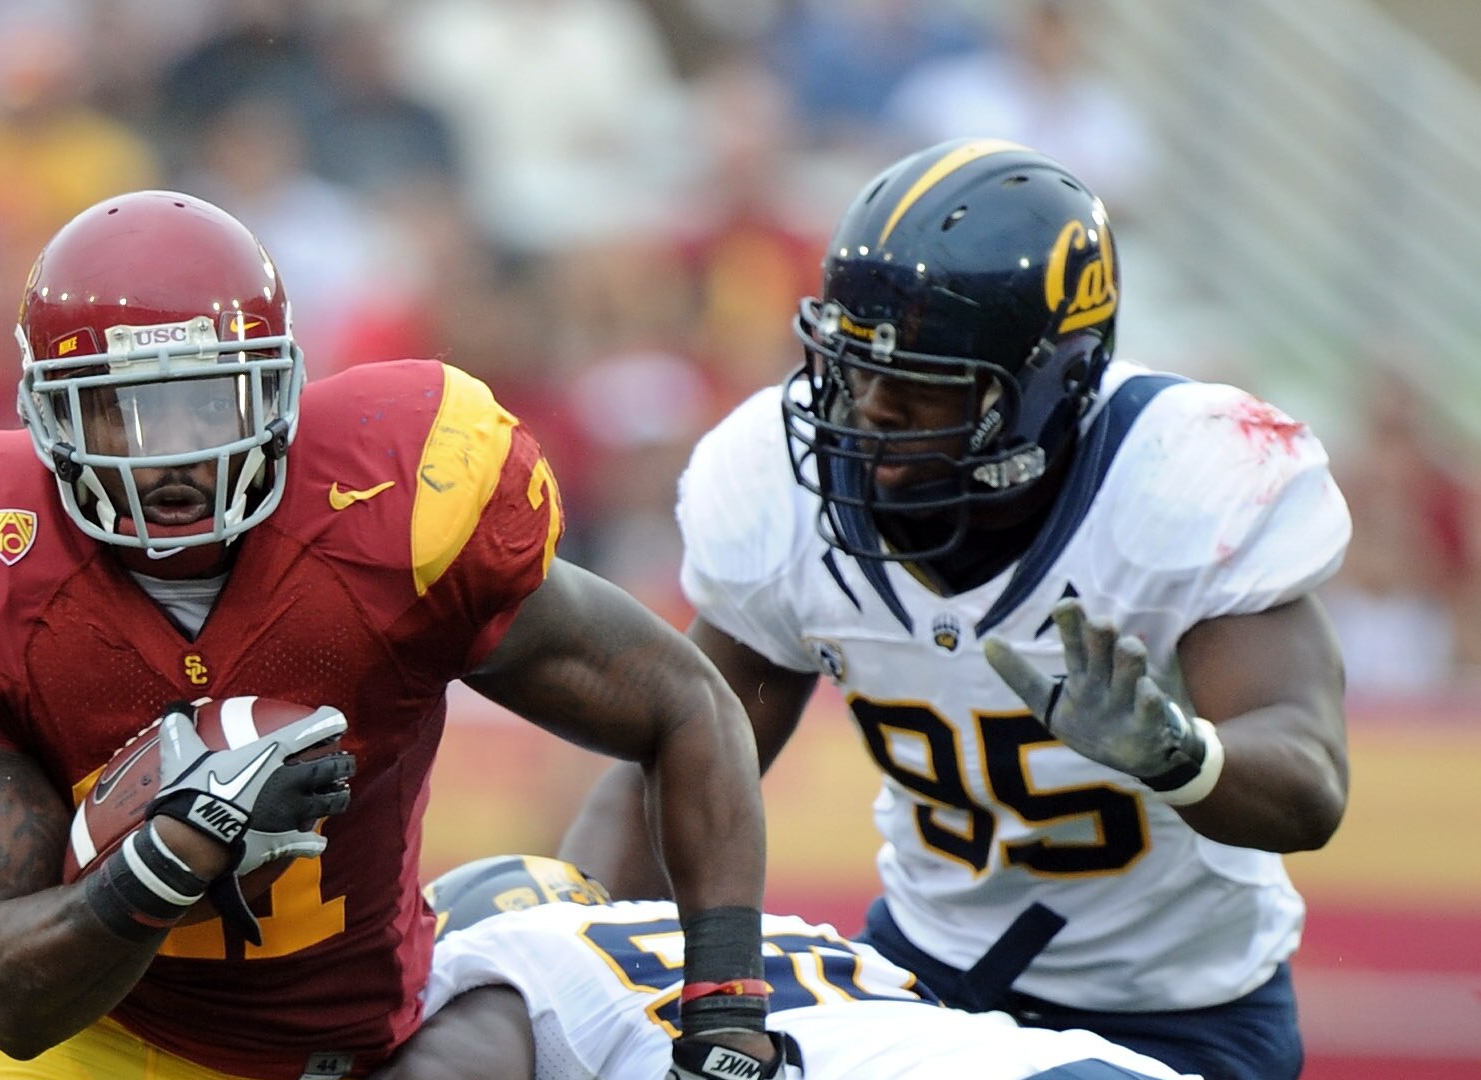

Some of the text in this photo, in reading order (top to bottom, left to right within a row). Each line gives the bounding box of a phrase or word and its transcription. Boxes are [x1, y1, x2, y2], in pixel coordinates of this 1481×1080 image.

[1044, 219, 1117, 313] Cal
[134, 326, 187, 347] USC
[184, 655, 208, 684] SC
[846, 691, 1153, 879] 95
[194, 799, 239, 839] NIKE
[710, 1052, 761, 1080] NIKE
